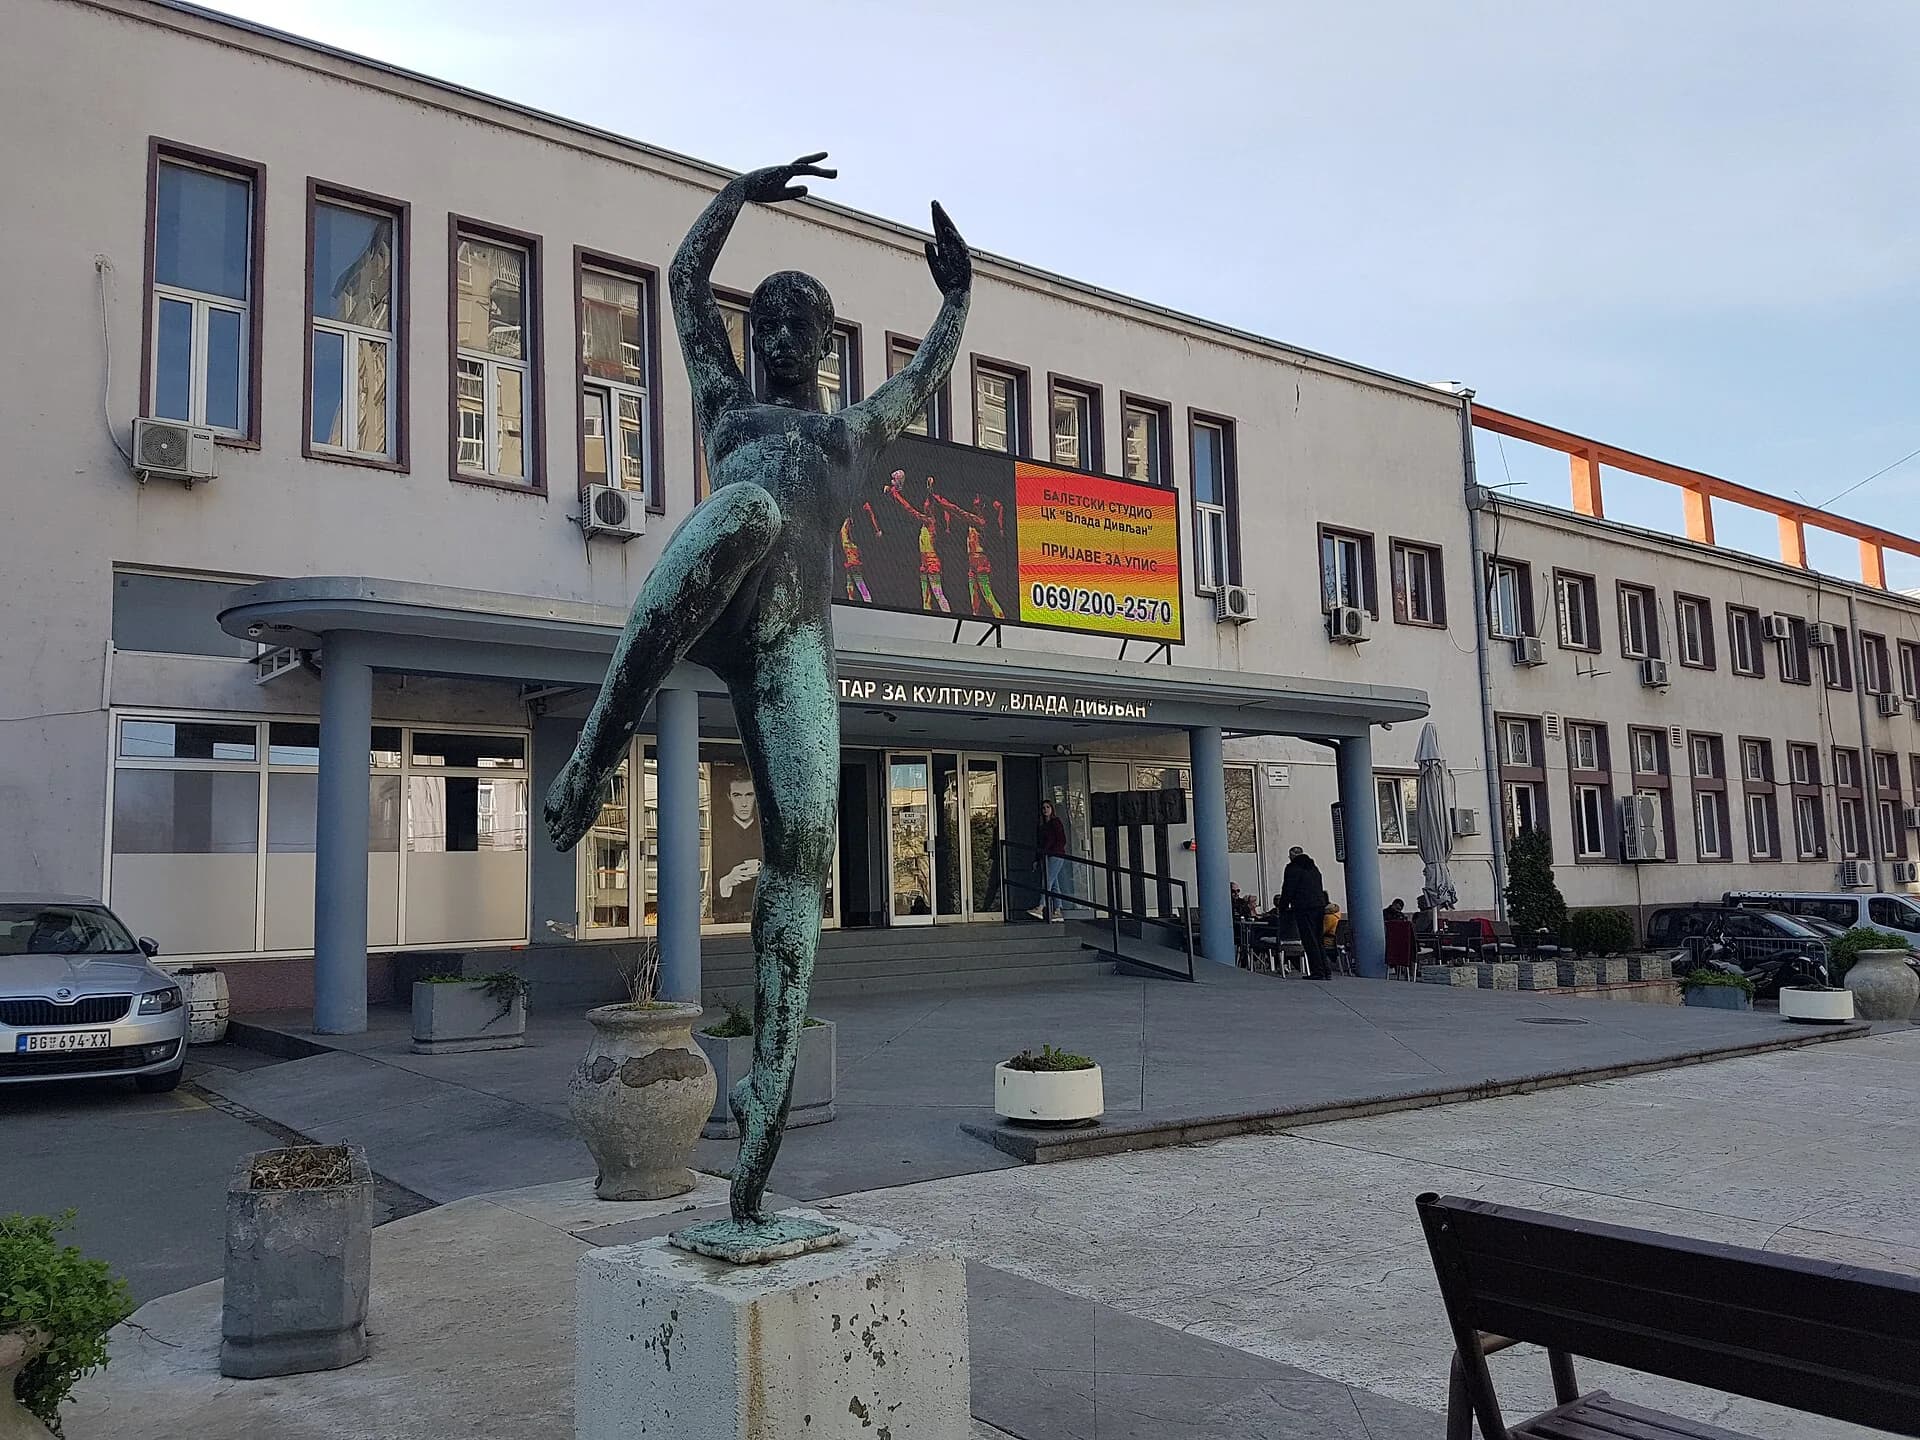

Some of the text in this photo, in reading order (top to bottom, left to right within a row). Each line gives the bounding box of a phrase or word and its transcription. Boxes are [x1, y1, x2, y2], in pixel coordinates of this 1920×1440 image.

[1041, 506, 1057, 521] ЦК
[1043, 489, 1153, 520] БАЛЕТСКИ СТУДИО
[1041, 542, 1158, 572] ПРИЈАВЕ ЗА УПИС
[1032, 583, 1172, 623] 069/200-2570
[838, 679, 877, 699] ТАР
[882, 683, 908, 702] ЗА
[913, 685, 996, 708] КУЛТУРУ
[29, 1036, 47, 1050] BG
